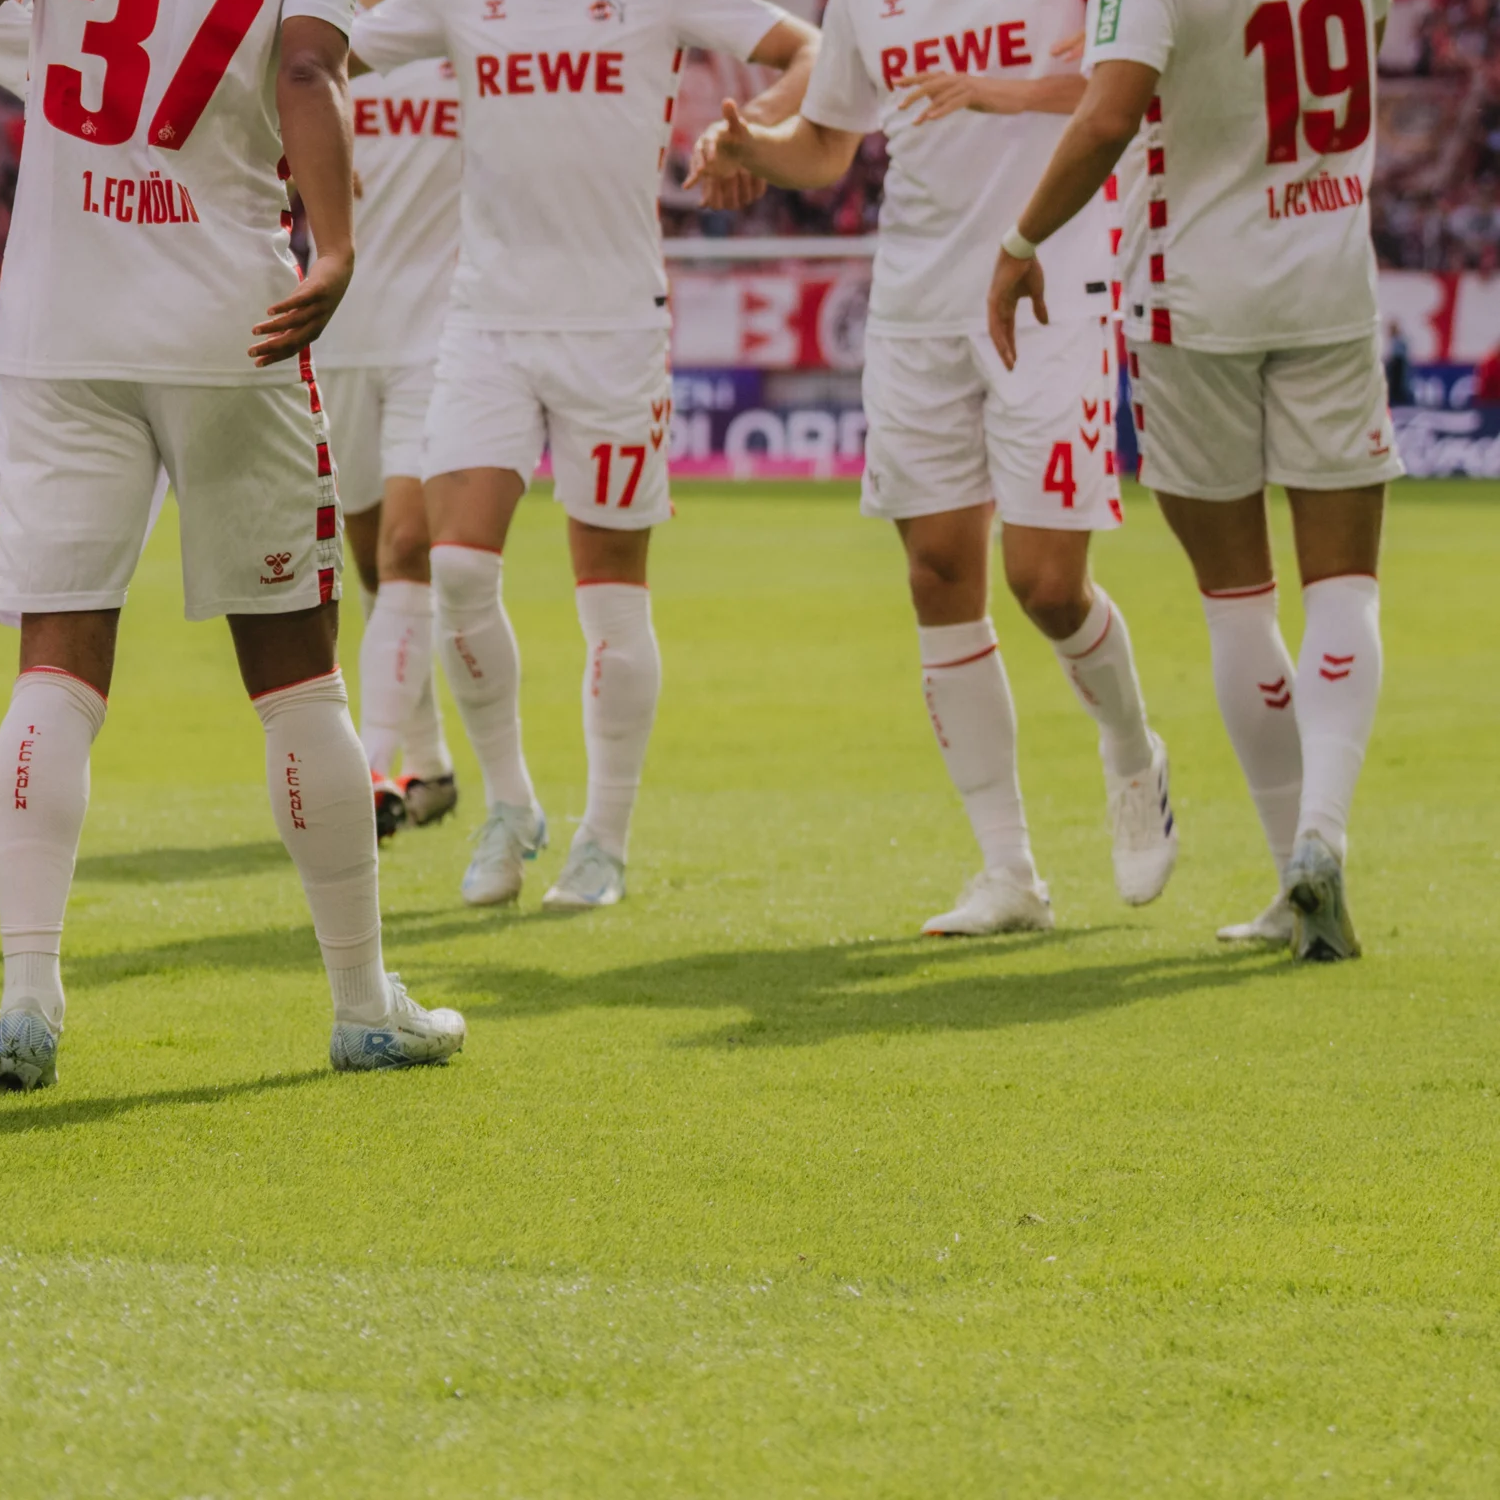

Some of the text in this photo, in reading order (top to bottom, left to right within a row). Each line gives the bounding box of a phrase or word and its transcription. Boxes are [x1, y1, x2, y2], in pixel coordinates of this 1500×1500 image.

[476, 51, 625, 98] REWE
[881, 20, 1032, 93] REWE
[82, 171, 200, 224] 1. FC KÖLN
[1266, 171, 1364, 220] 1. FC KÖLN
[591, 442, 646, 509] 17
[1043, 440, 1077, 508] 4
[260, 571, 295, 585] hummel
[20, 740, 34, 762] FC
[15, 766, 29, 810] KÖLN
[286, 767, 300, 786] FC
[289, 789, 306, 830] KÖLN
